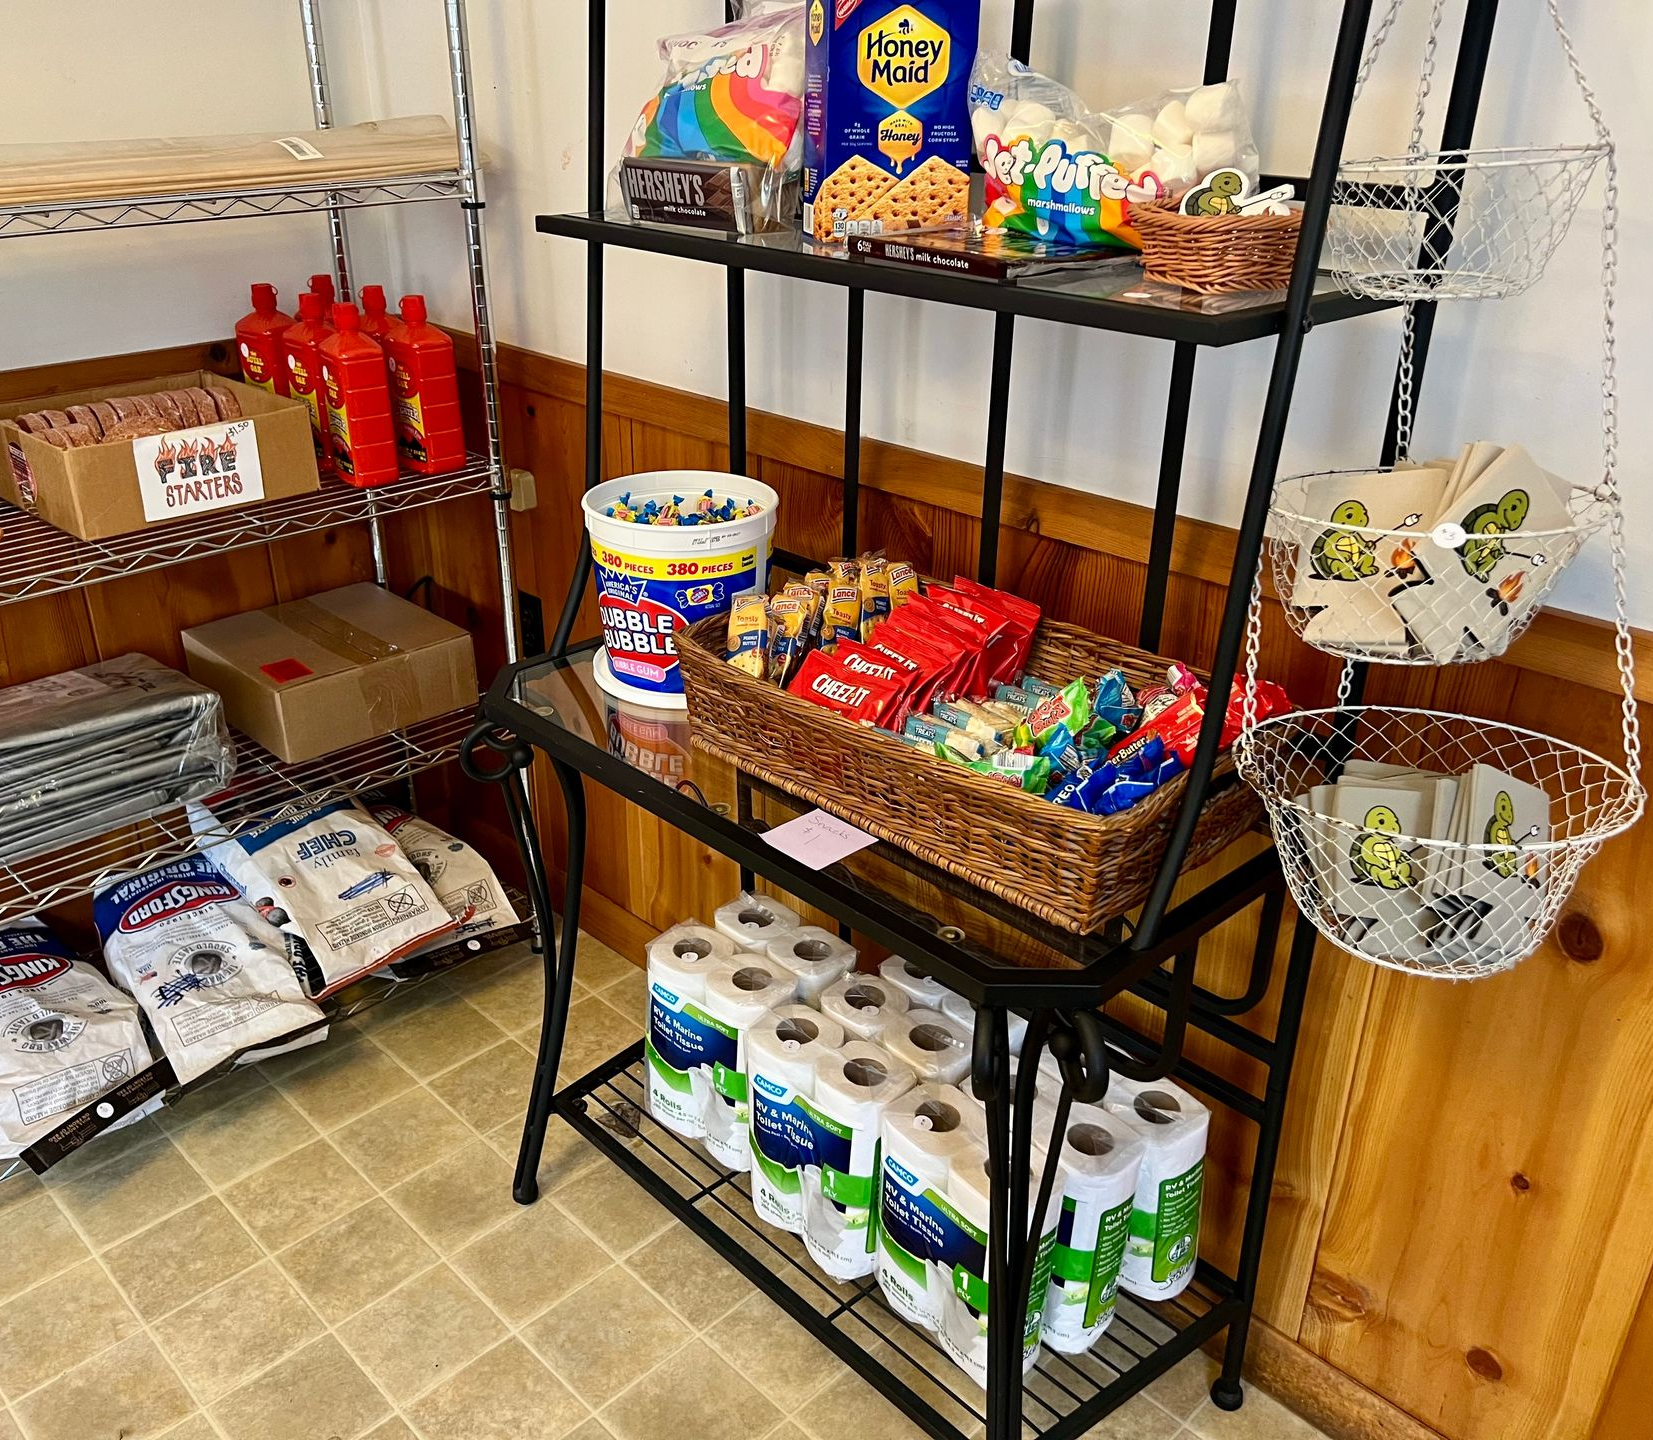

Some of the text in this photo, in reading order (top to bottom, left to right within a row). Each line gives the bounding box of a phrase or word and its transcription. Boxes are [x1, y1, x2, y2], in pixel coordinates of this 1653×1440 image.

[867, 30, 944, 66] Honey
[871, 59, 929, 87] Maid
[880, 129, 922, 146] Honey
[626, 167, 706, 207] HERSHEY'S
[663, 204, 707, 217] milk chocolate
[1027, 198, 1096, 216] marshmallows
[835, 222, 845, 230] 130
[857, 239, 863, 252] 6
[884, 244, 969, 269] HERSHEY'S milk chocolate
[227, 421, 249, 438] $1.50
[156, 447, 238, 484] FIRE
[166, 472, 244, 508] STARTERS
[602, 550, 654, 575] 380 PIECES
[666, 562, 734, 576] 380 PIECES
[891, 568, 913, 580] Lance
[605, 580, 639, 595] AMERICA'S
[832, 589, 857, 598] Lance
[870, 580, 887, 590] Toasty
[600, 606, 674, 634] DUBBLE
[736, 615, 759, 623] Toasty
[833, 608, 851, 620] Toasty
[604, 629, 678, 655] BUBBLE
[636, 665, 659, 678] GUM
[1006, 693, 1027, 704] TREATS
[940, 713, 958, 726] TREATS
[915, 728, 936, 740] TREATS
[1119, 737, 1147, 760] Butter
[1052, 784, 1076, 804] REO
[296, 830, 357, 861] CHEF
[314, 848, 361, 869] family
[110, 861, 220, 904] HE ORIGINAL
[128, 884, 232, 926] KINGSFORD
[159, 906, 214, 927] SINCE 1920
[172, 942, 233, 965] SHOULD TASTE
[0, 958, 61, 986] KINGS
[654, 984, 676, 1003] CAMCO
[255, 1001, 281, 1014] ARNING
[653, 1005, 664, 1018] RV
[665, 1015, 672, 1025] &
[673, 1019, 703, 1042] Marine
[653, 1015, 674, 1037] Toilet
[675, 1032, 704, 1052] Tissue
[697, 1013, 729, 1035] ULTRA SOFT
[717, 1067, 726, 1085] 1
[756, 1076, 783, 1095] CAMCO
[716, 1083, 728, 1094] PLY
[652, 1088, 682, 1111] 4 Rolls
[756, 1098, 768, 1114] RV
[770, 1108, 779, 1119] &
[781, 1111, 815, 1141] Marine
[807, 1109, 843, 1135] ULTRA SOFT
[756, 1110, 783, 1132] Toilet
[785, 1124, 814, 1150] Tissue
[826, 1170, 836, 1189] 1
[887, 1158, 914, 1184] CAMCO
[823, 1186, 838, 1199] PLY
[1165, 1182, 1178, 1192] RV
[1165, 1188, 1186, 1199] Toilet
[760, 1188, 791, 1215] 4 Rolls
[885, 1179, 899, 1197] RV
[899, 1194, 907, 1207] &
[909, 1202, 945, 1236] Marine
[884, 1191, 910, 1221] Toilet
[912, 1214, 944, 1248] Tissue
[941, 1204, 960, 1225] ULTRA
[960, 1221, 978, 1238] SOFT
[1104, 1217, 1123, 1232] Toilet
[1105, 1213, 1117, 1224] RV
[882, 1268, 914, 1302] 4 Rolls
[959, 1271, 969, 1291] 1
[957, 1286, 972, 1301] PLY
